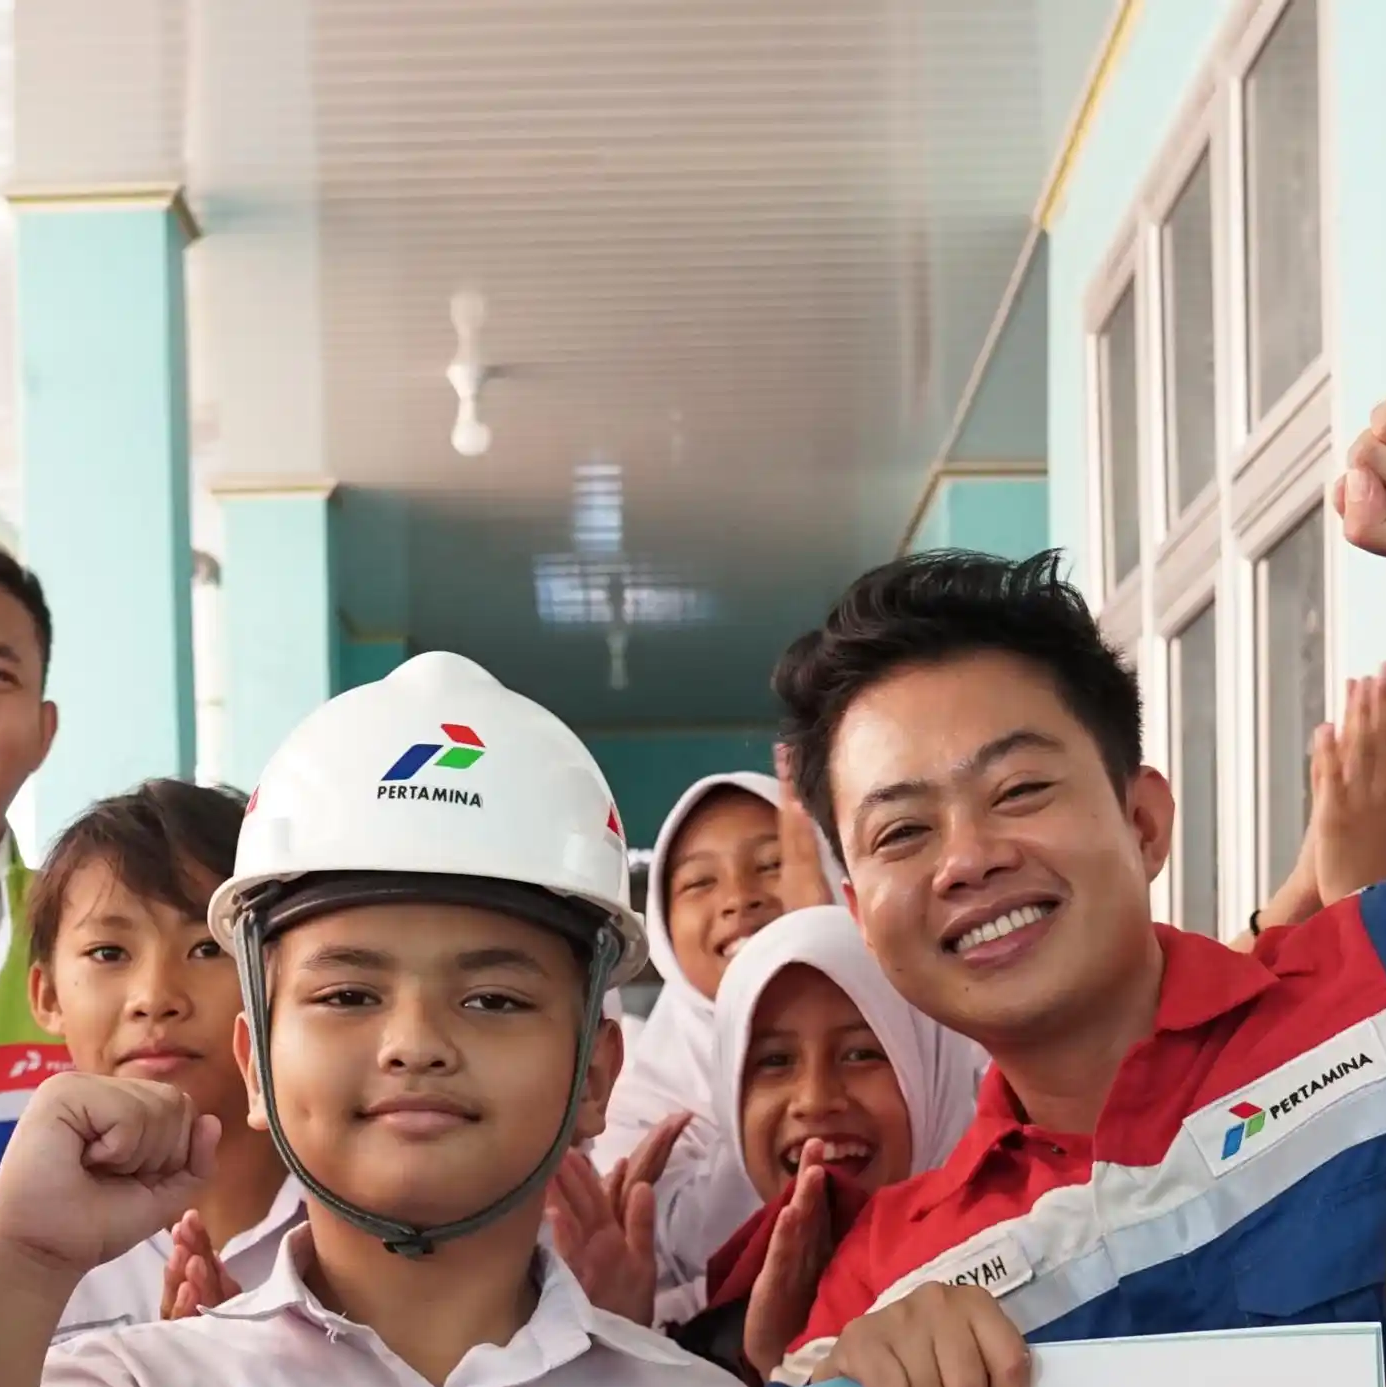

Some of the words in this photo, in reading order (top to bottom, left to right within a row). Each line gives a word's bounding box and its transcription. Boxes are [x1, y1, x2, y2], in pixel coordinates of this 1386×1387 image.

[377, 785, 482, 808] PERTAMINA
[1269, 1053, 1373, 1120] PERTAMINA
[947, 1256, 1007, 1287] SYAH
